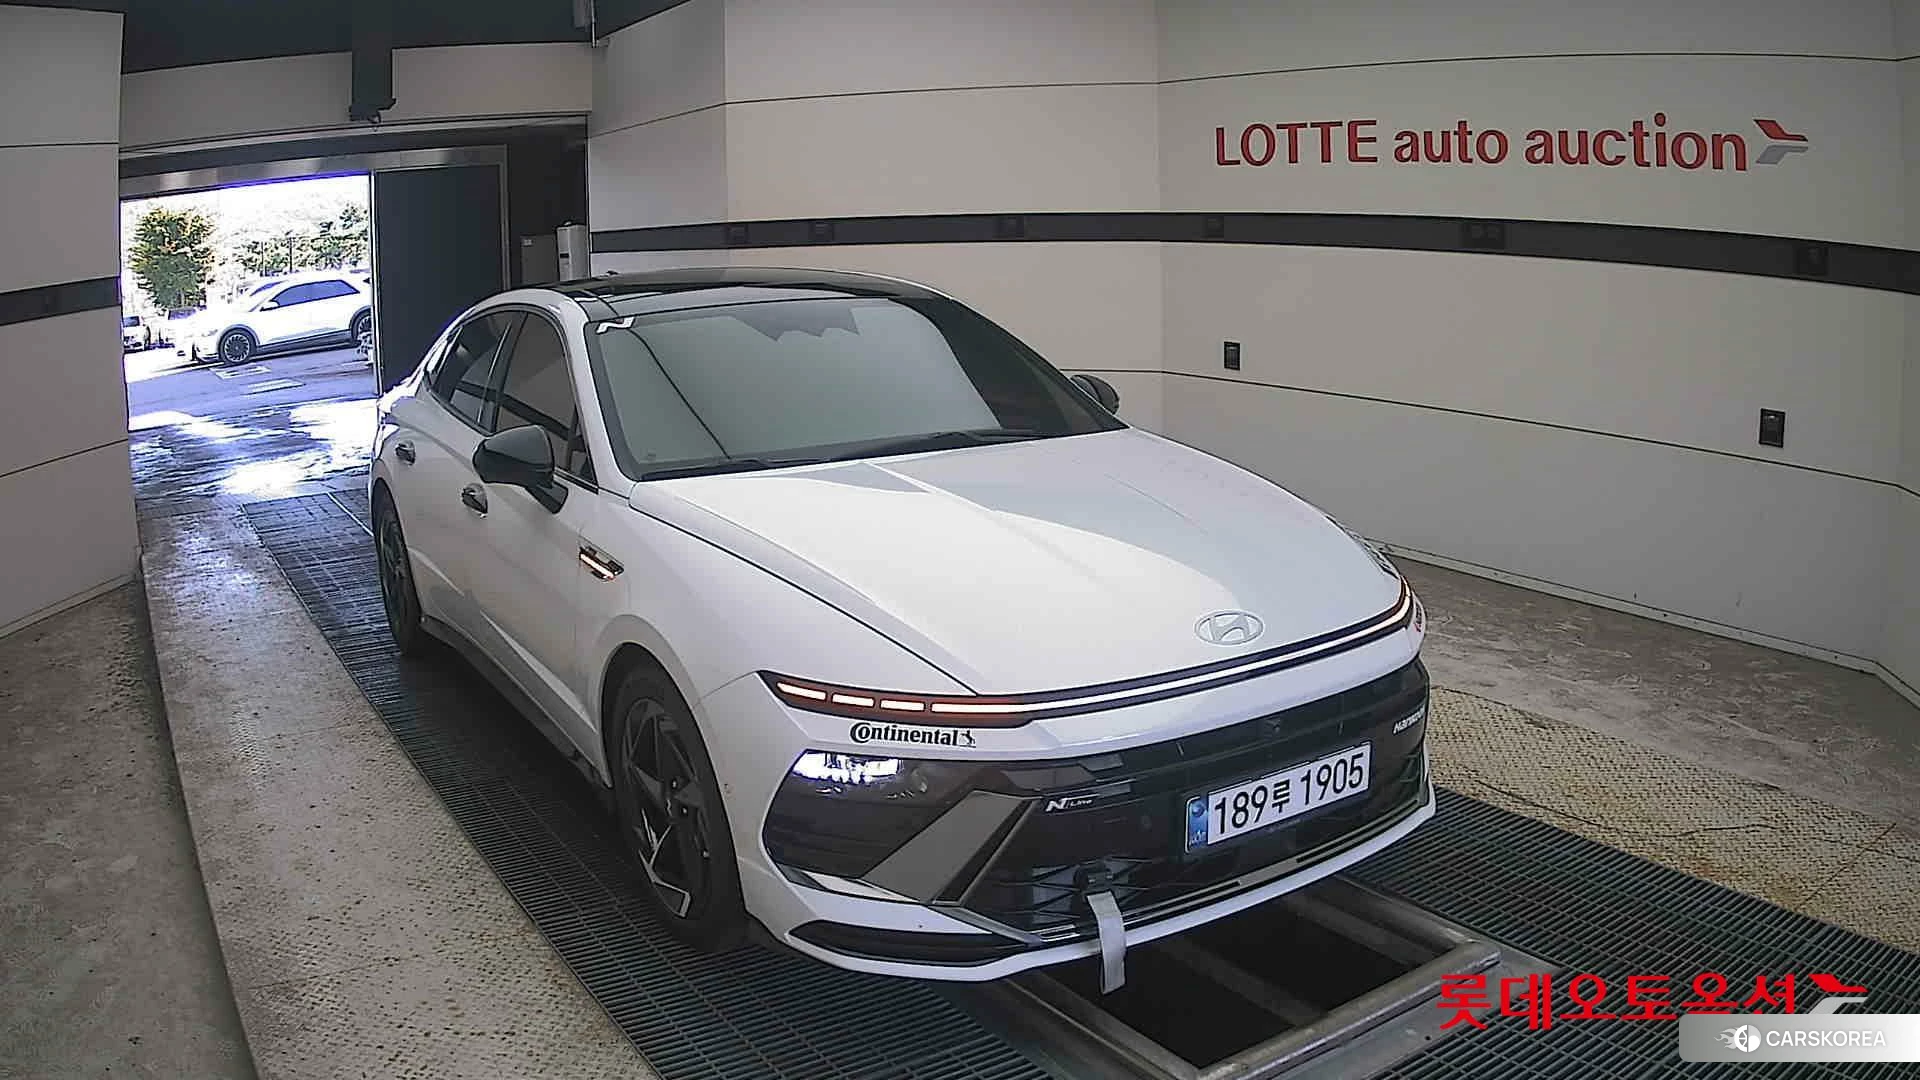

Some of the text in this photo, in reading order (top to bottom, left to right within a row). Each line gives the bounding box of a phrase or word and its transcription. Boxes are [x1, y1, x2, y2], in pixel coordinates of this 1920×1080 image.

[1215, 112, 1748, 172] LOTTE auto auction
[850, 722, 959, 747] Continental
[1214, 752, 1364, 835] 189루 1905
